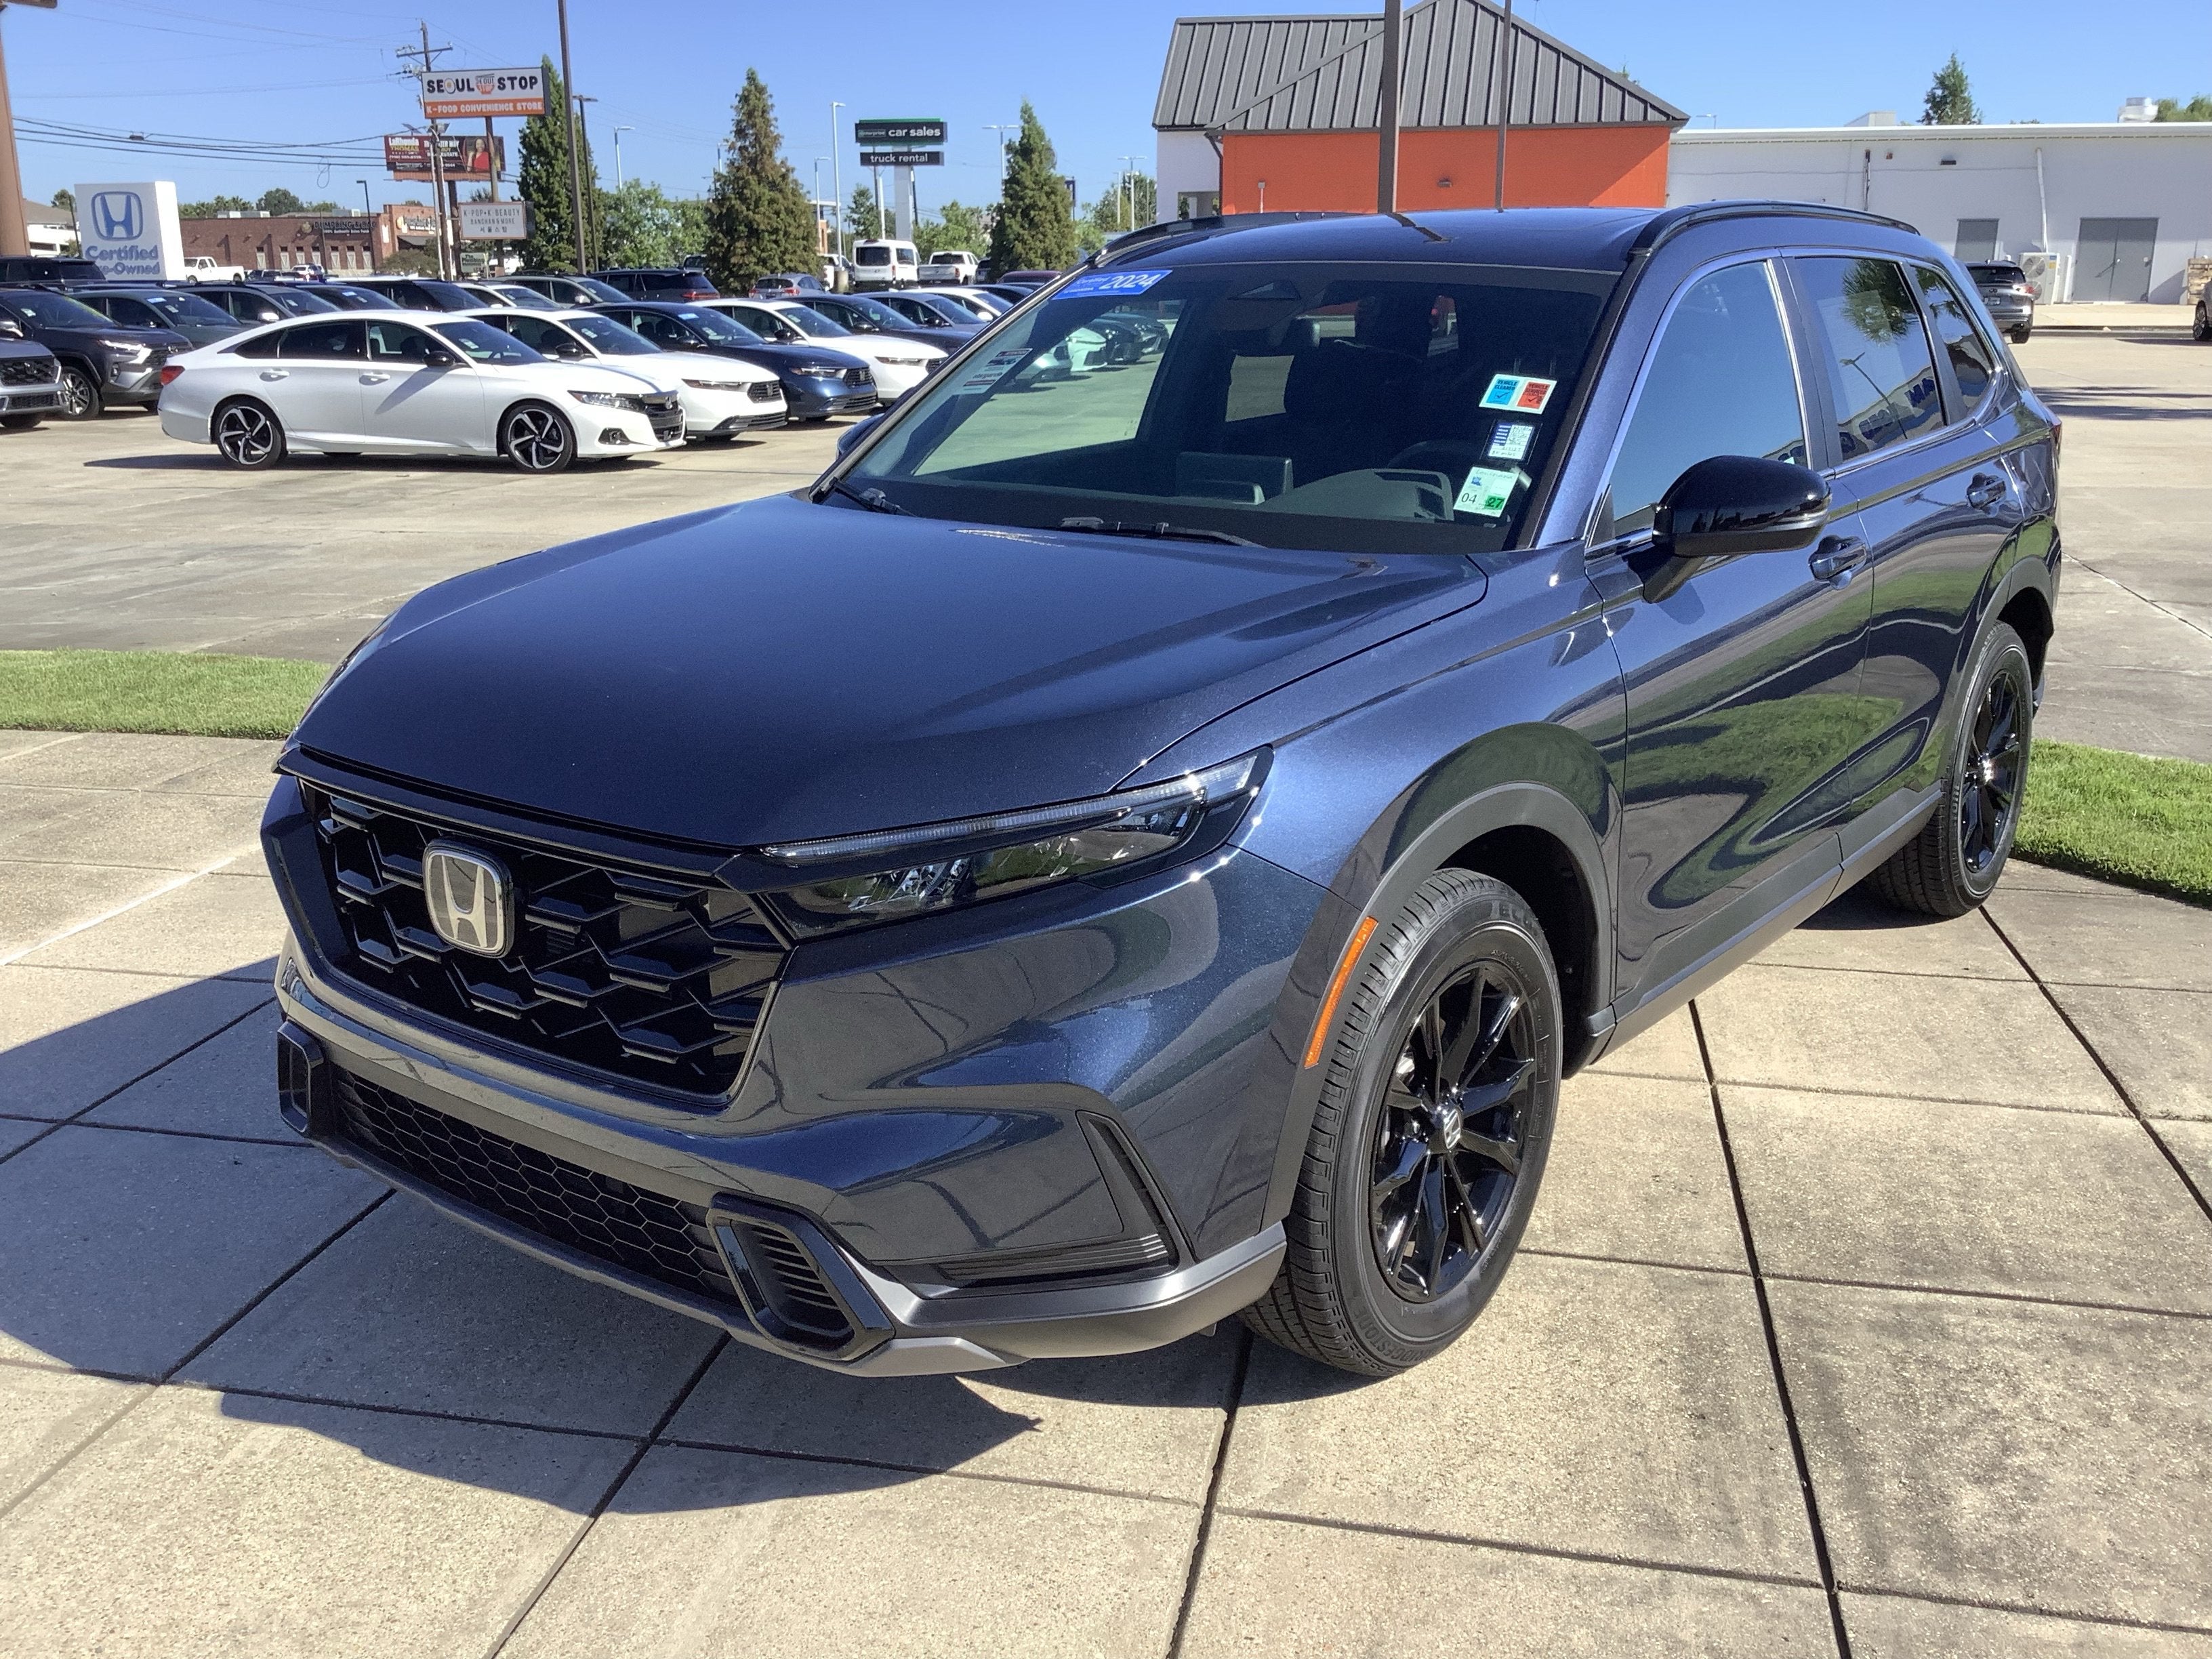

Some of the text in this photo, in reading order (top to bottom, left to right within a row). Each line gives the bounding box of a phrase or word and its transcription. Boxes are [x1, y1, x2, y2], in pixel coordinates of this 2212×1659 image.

[426, 75, 538, 95] SEOUL STOP
[426, 102, 542, 114] K-FOOD CONVENIENCE STORE
[888, 128, 908, 137] car
[909, 125, 941, 137] sales
[870, 152, 928, 163] truck rental
[85, 244, 159, 262] Certified
[1098, 273, 1162, 290] 2024
[1461, 493, 1477, 504] 04
[1486, 497, 1506, 508] 27
